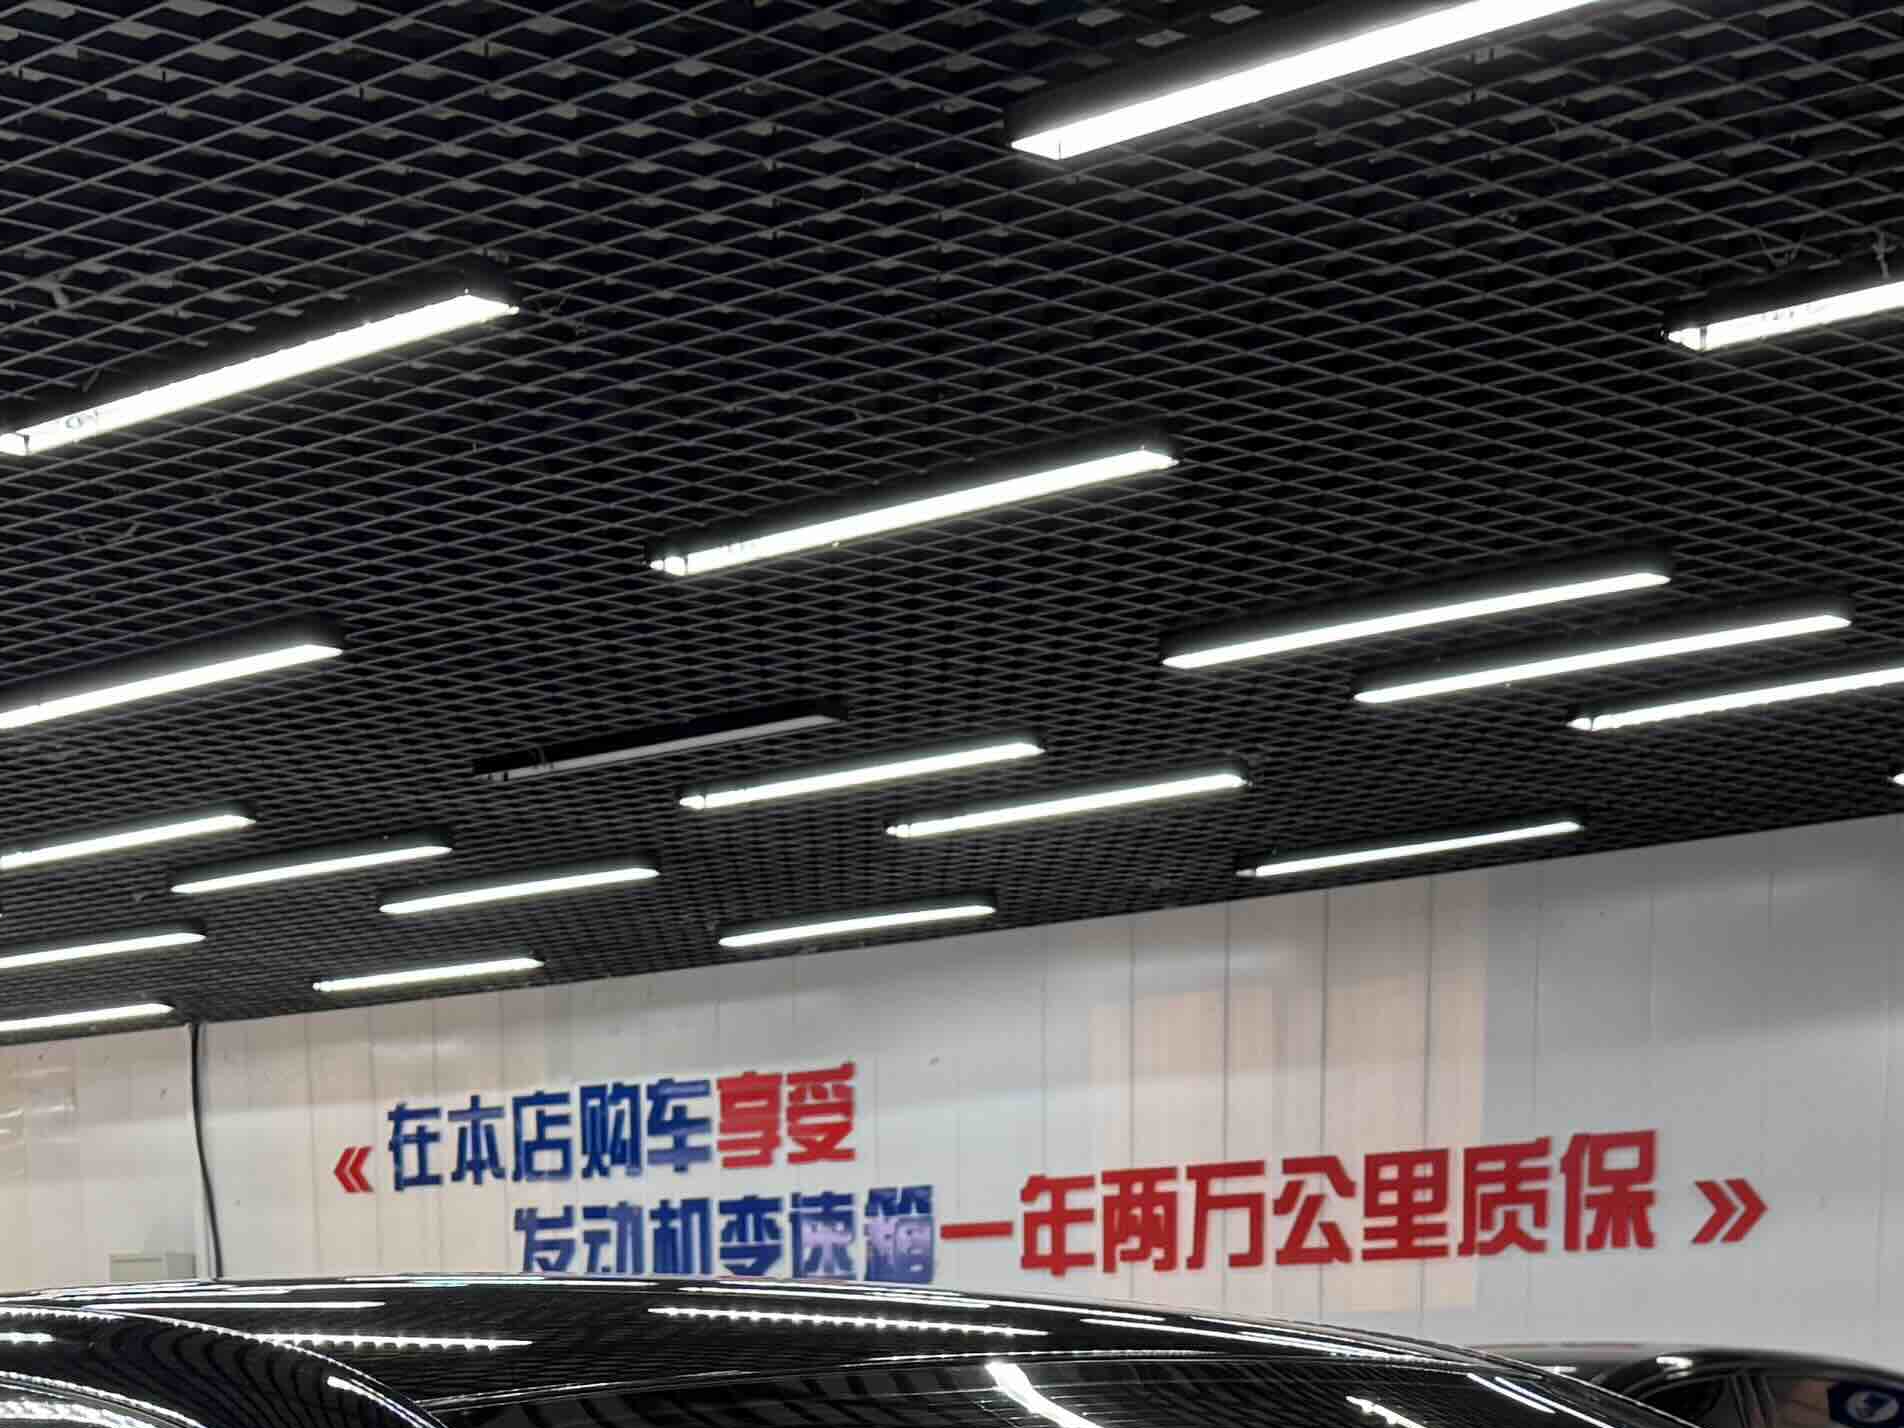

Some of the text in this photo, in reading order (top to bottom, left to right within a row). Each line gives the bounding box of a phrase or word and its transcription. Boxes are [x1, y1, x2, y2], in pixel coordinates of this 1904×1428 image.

[387, 1061, 856, 1192] 在本店购车享受
